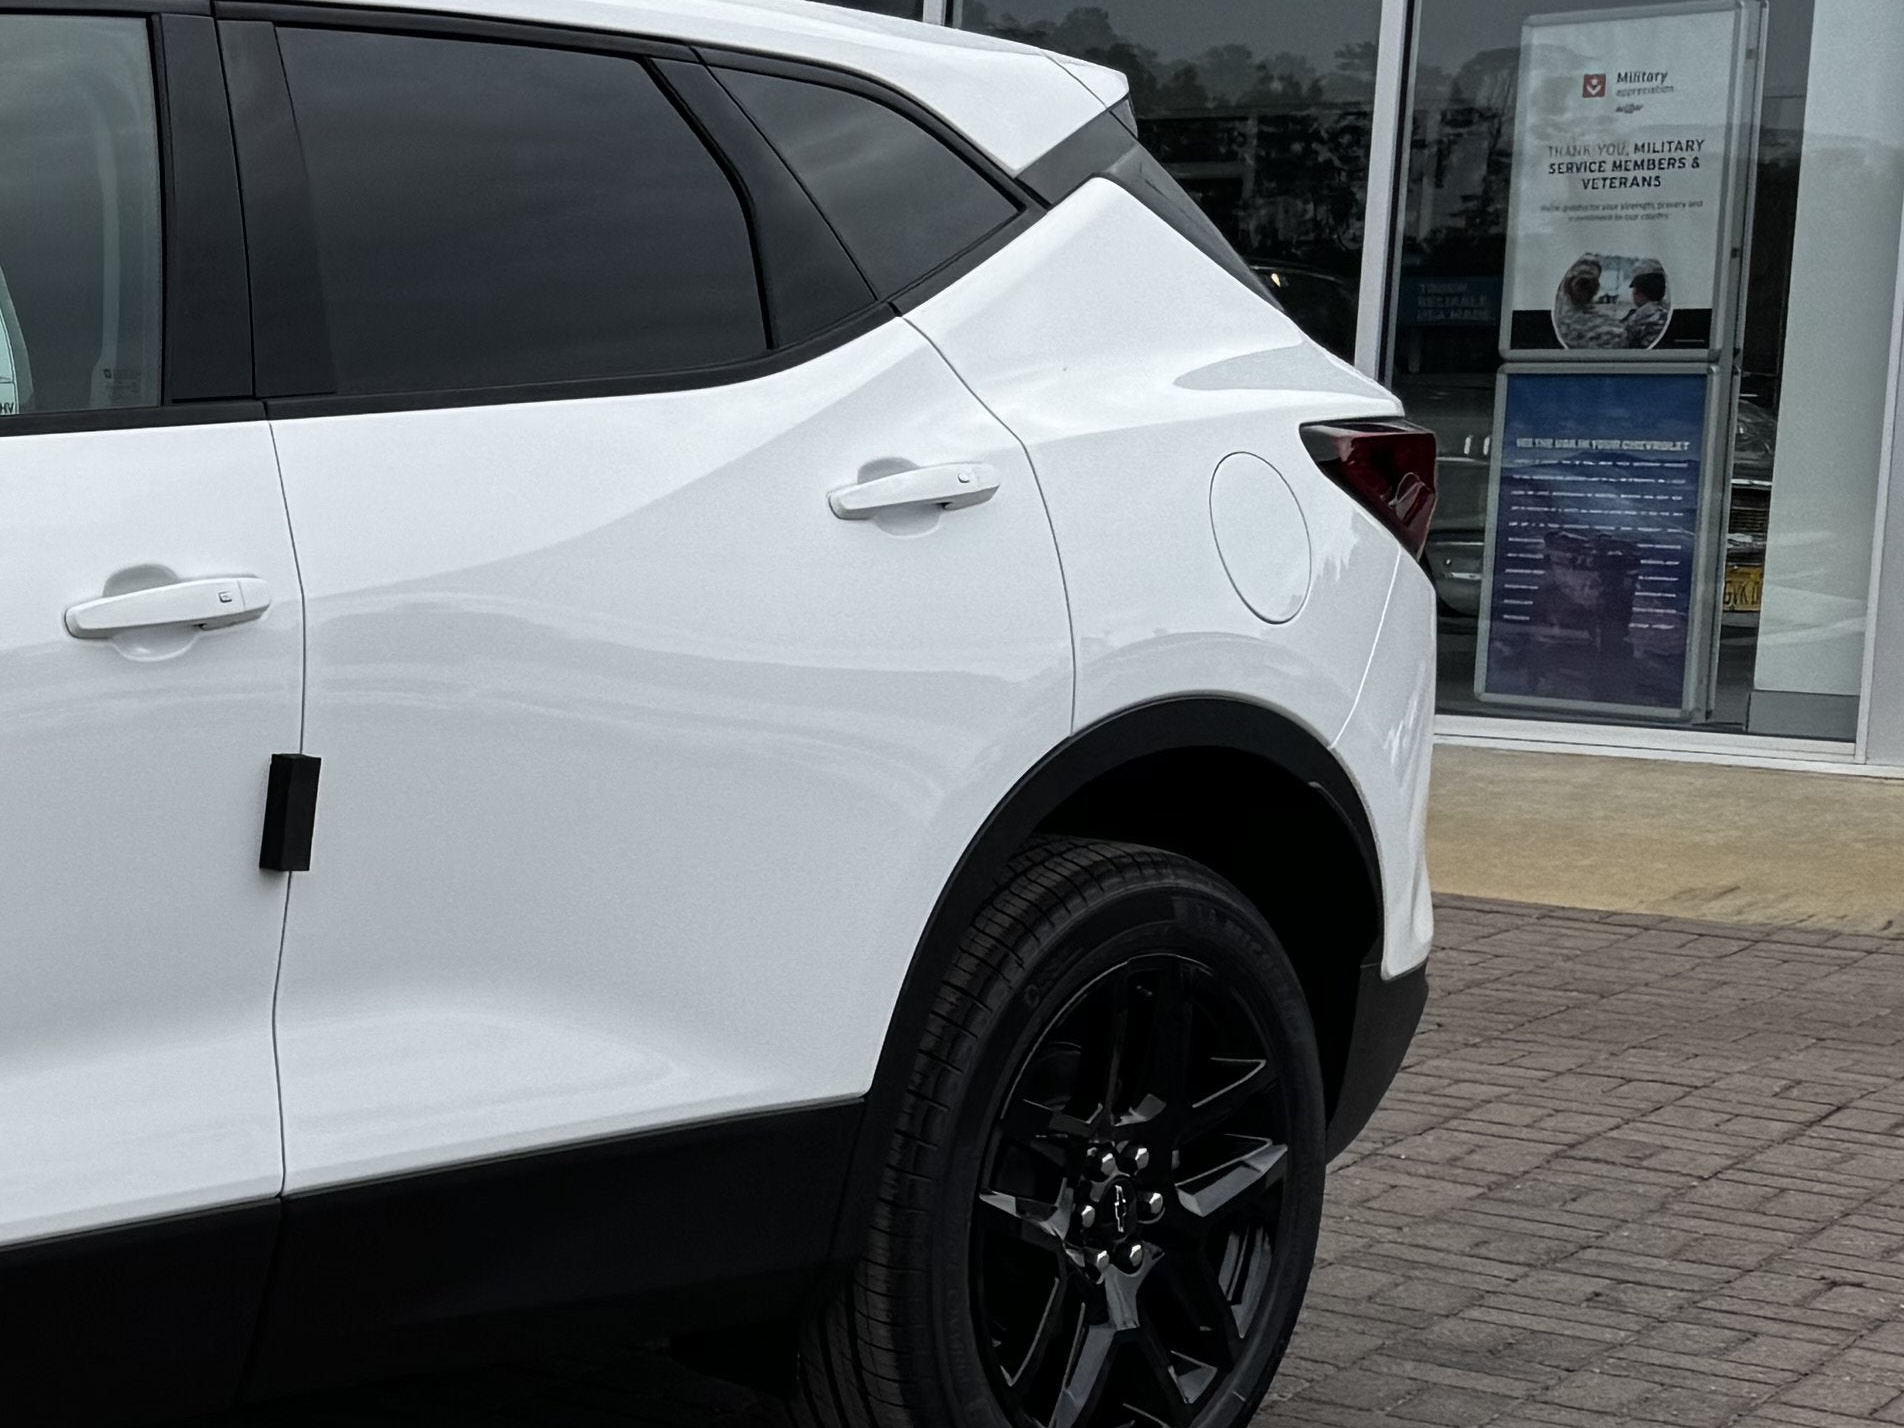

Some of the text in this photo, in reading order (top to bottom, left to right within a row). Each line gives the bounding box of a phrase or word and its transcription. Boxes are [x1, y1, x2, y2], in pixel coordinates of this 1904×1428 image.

[1616, 71, 1669, 85] Military
[1548, 144, 1592, 158] THANK
[1634, 139, 1706, 154] MILITARY
[1549, 156, 1701, 175] SERVICE MEMBERS &
[1582, 175, 1662, 190] VETERANS
